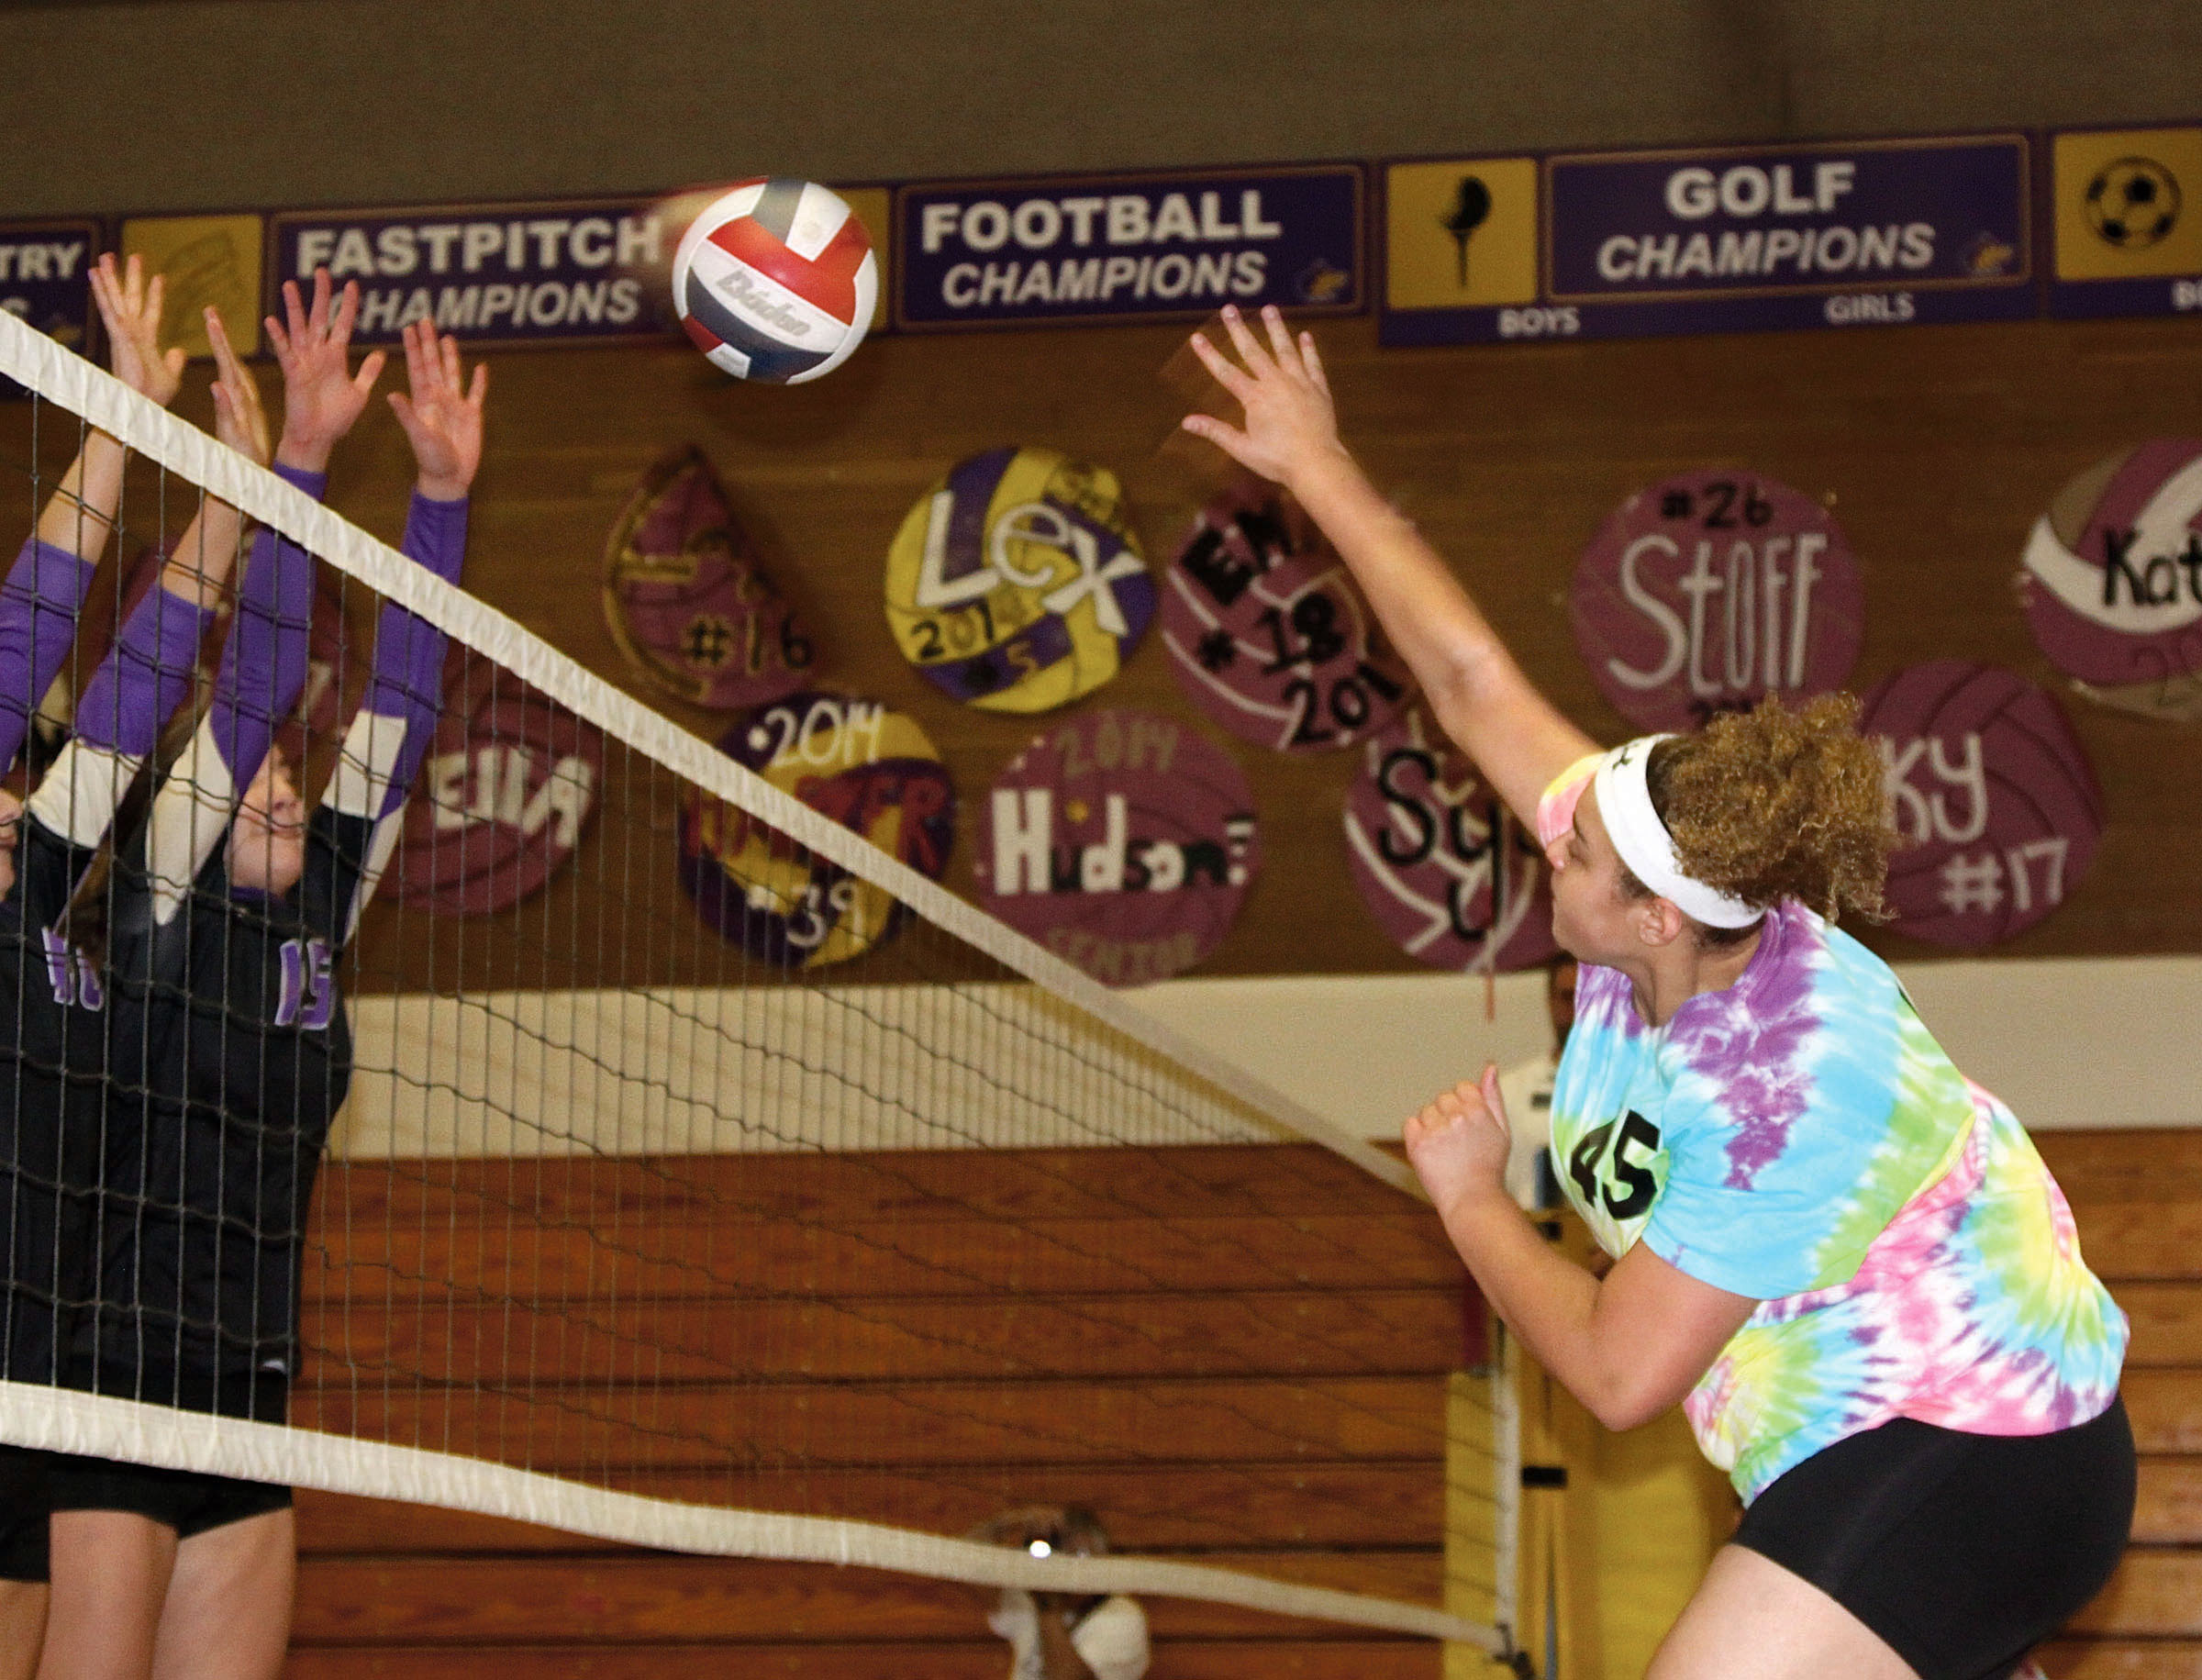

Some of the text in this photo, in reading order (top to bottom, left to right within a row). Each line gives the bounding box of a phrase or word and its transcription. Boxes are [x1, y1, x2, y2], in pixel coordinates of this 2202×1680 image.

[1665, 161, 1856, 218] GOLF
[296, 216, 662, 279] FASTPITCH
[921, 189, 1283, 253] FOOTBALL
[941, 250, 1269, 307] CHAMPIONS
[1596, 222, 1937, 282] CHAMPIONS
[1497, 306, 1580, 337] BOYS
[1824, 293, 1915, 323] GIRLS
[1662, 481, 1773, 529] #26
[916, 489, 1146, 638] Lex
[1938, 836, 2070, 915] #17
[274, 938, 337, 1030] 15
[1570, 1108, 1662, 1221] 45
